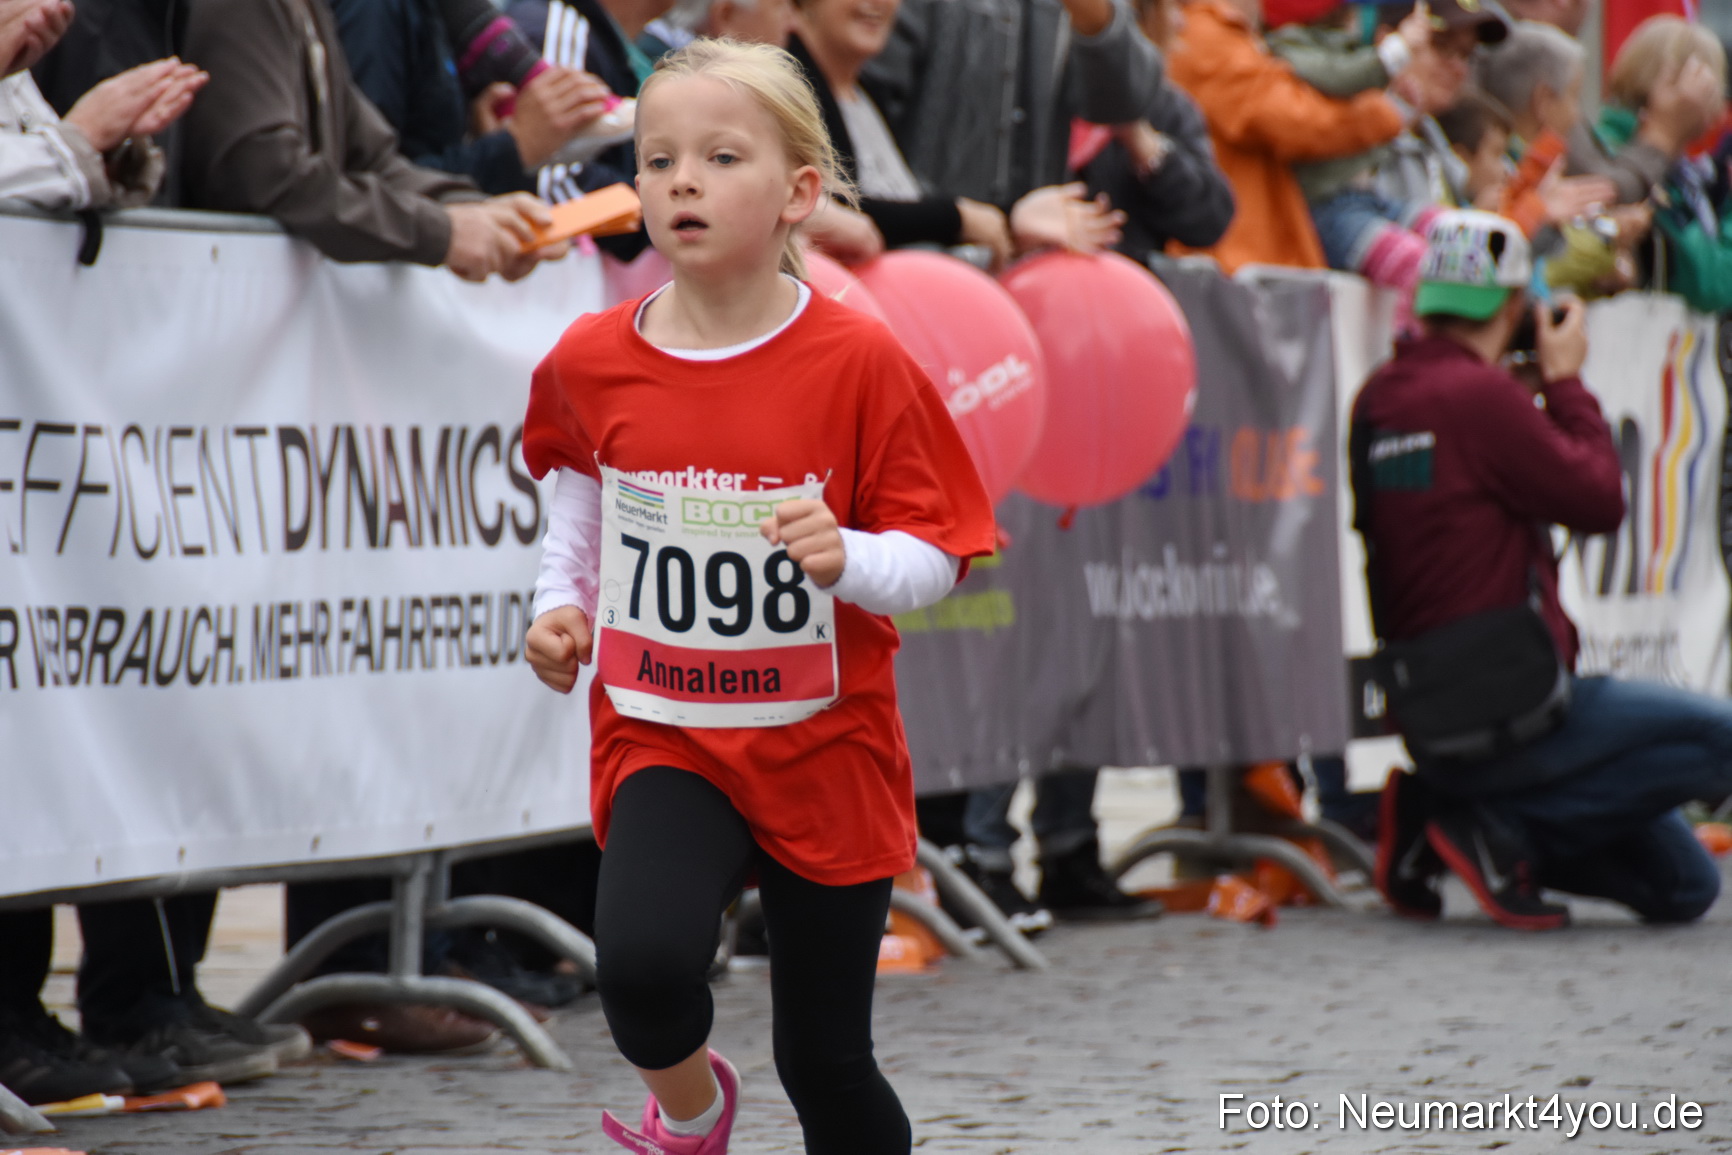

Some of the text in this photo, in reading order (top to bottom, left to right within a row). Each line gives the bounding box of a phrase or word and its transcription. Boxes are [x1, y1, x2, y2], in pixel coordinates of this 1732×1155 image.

[615, 498, 668, 525] NeuerMarkt
[681, 496, 790, 527] BOC
[621, 532, 811, 637] 7098
[607, 609, 615, 625] 3
[816, 624, 826, 639] K
[251, 601, 333, 681] MEHR
[636, 649, 782, 694] Annalena
